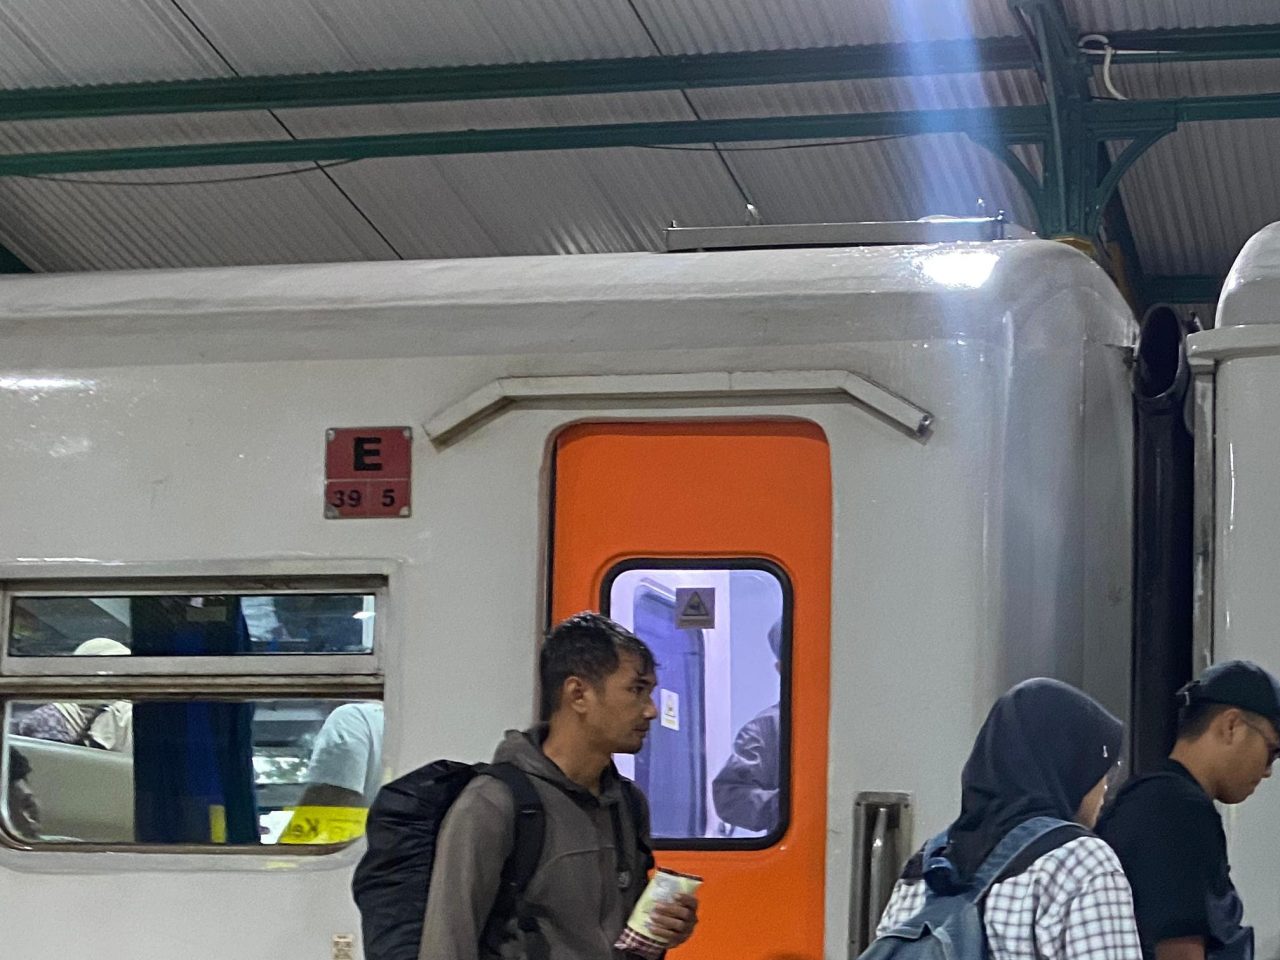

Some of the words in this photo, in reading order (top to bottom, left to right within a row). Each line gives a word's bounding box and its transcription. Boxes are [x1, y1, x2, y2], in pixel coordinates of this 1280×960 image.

[353, 436, 383, 472] E
[331, 489, 363, 508] 39
[382, 488, 396, 507] 5
